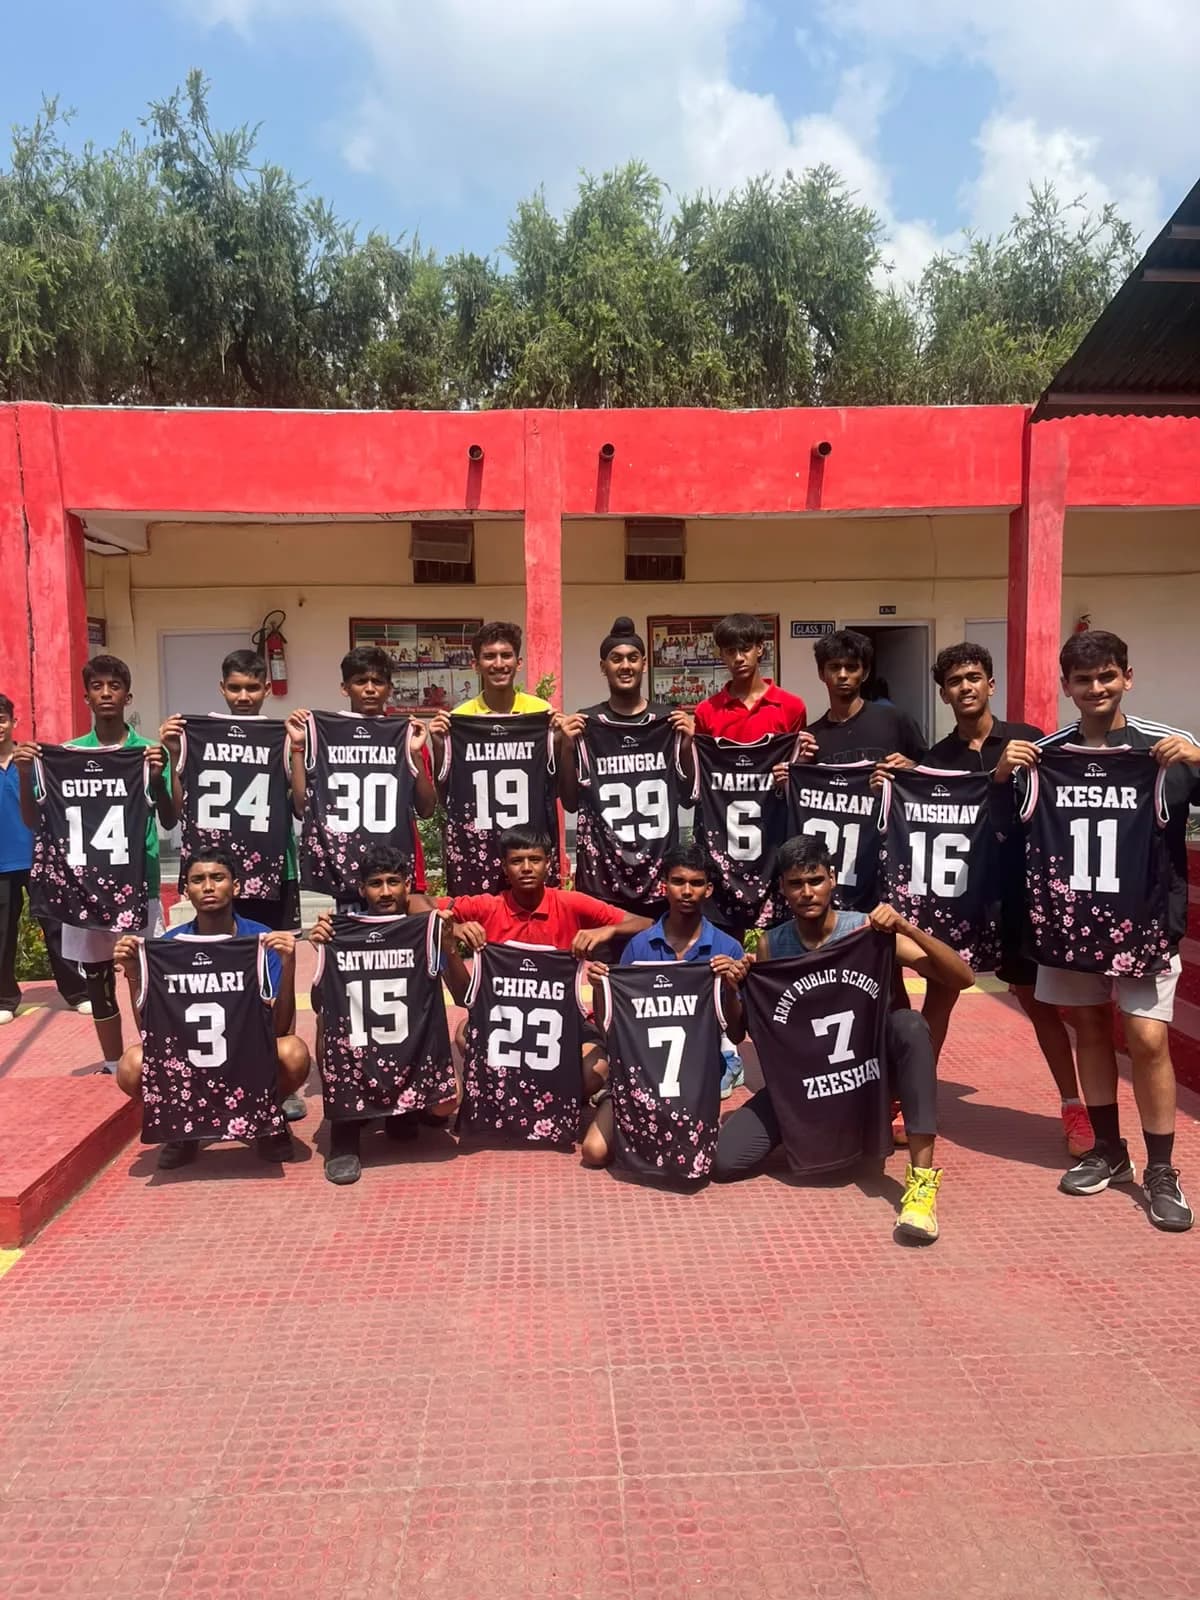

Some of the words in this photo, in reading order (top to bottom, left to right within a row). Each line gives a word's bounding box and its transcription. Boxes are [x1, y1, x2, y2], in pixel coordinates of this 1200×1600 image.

[796, 624, 819, 634] CLASS
[203, 743, 270, 765] ARPAN
[328, 745, 397, 765] KOKITKAR
[464, 741, 535, 762] ALHAWAT
[597, 752, 667, 776] DHINGRA
[61, 778, 128, 798] GUPTA
[197, 769, 271, 833] 24
[327, 772, 398, 833] 30
[472, 768, 529, 830] 19
[599, 779, 670, 843] 29
[799, 788, 875, 816] SHARAN
[904, 801, 980, 825] VAISHNAV
[1055, 785, 1137, 810] KESAR
[65, 805, 130, 866] 14
[726, 800, 763, 862] 6
[1069, 818, 1120, 893] 11
[908, 831, 971, 898] 16
[164, 971, 245, 994] TIWARI
[337, 948, 415, 972] SATWINDER
[345, 978, 409, 1047] 15
[492, 976, 565, 1000] CHIRAG
[631, 995, 699, 1019] YADAV
[772, 988, 797, 1025] ARMY
[792, 968, 837, 996] PUBLIC
[841, 969, 881, 1000] SCHOOL
[184, 1002, 228, 1069] 3
[487, 1005, 564, 1071] 23
[811, 1009, 856, 1065] 7
[648, 1025, 687, 1098] 7
[802, 1056, 880, 1100] ZEESHAN
